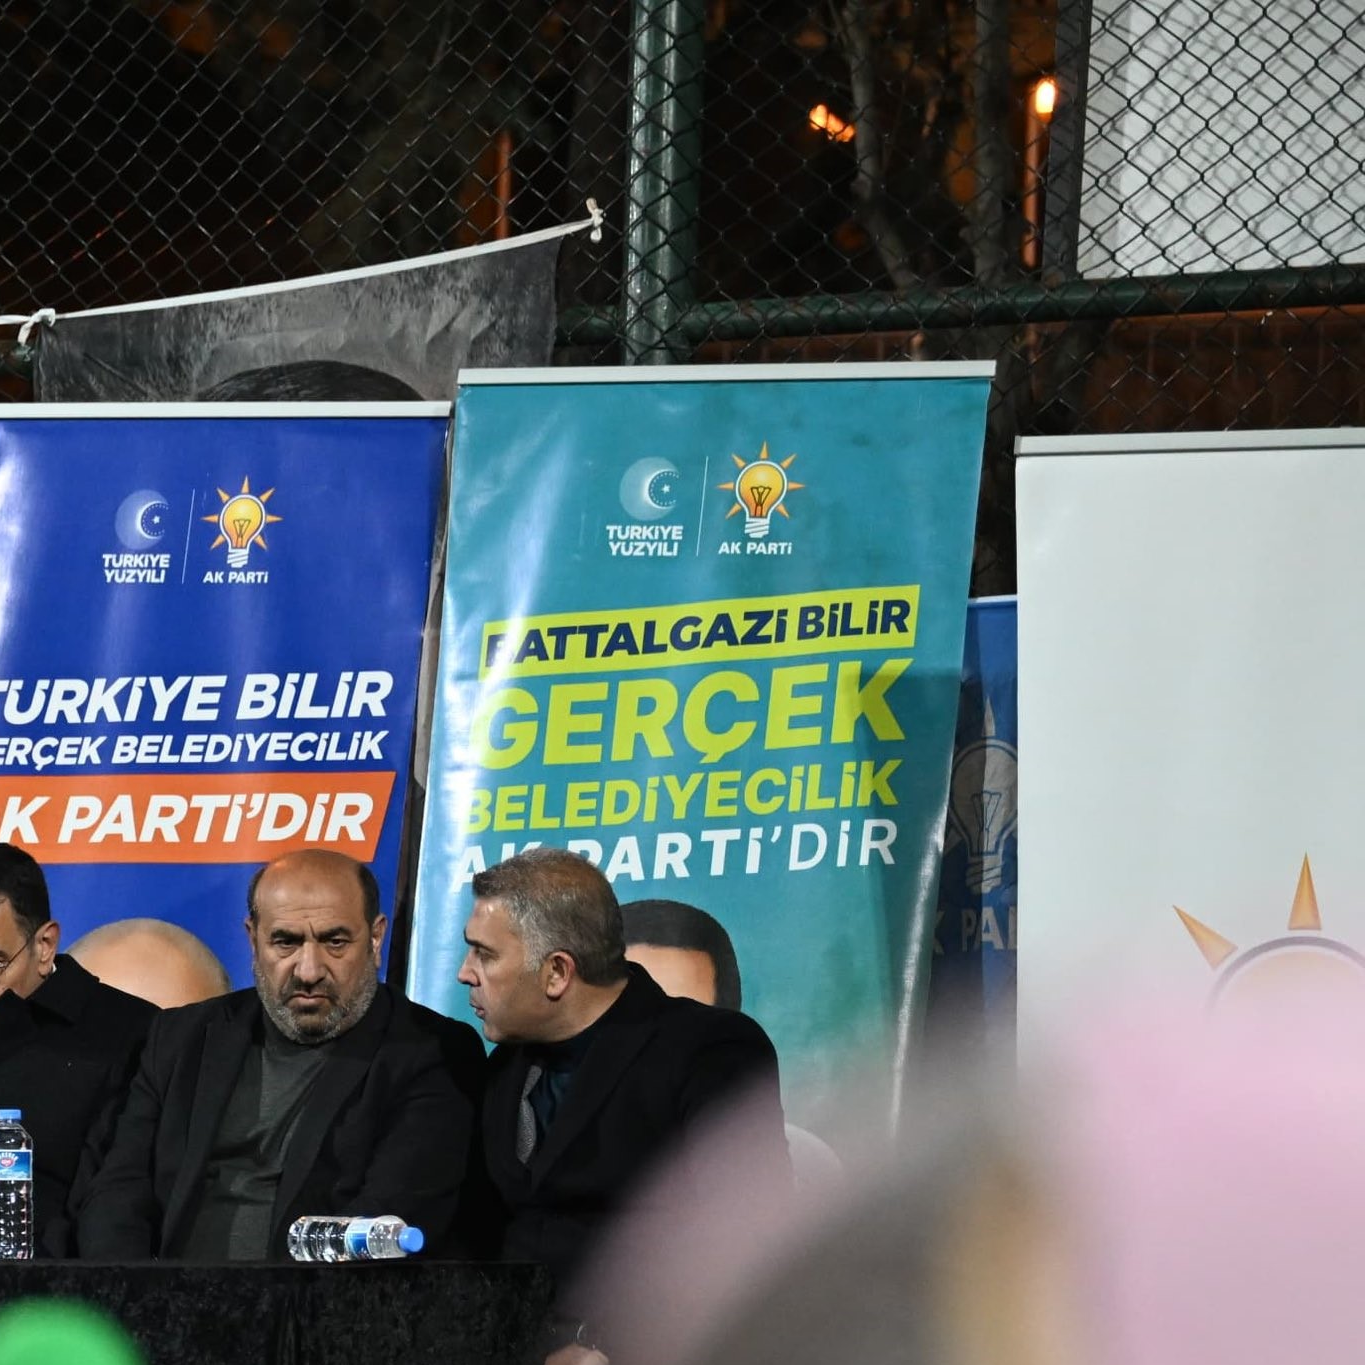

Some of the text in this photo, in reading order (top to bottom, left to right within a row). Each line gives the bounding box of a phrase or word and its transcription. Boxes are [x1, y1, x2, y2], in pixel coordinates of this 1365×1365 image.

[718, 542, 741, 555] AK
[202, 572, 224, 583] AK
[797, 599, 912, 638] BİLİR
[235, 670, 394, 721] BİLİR
[473, 658, 914, 770] GERÇEK
[111, 730, 389, 765] BELEDİYECİLİK
